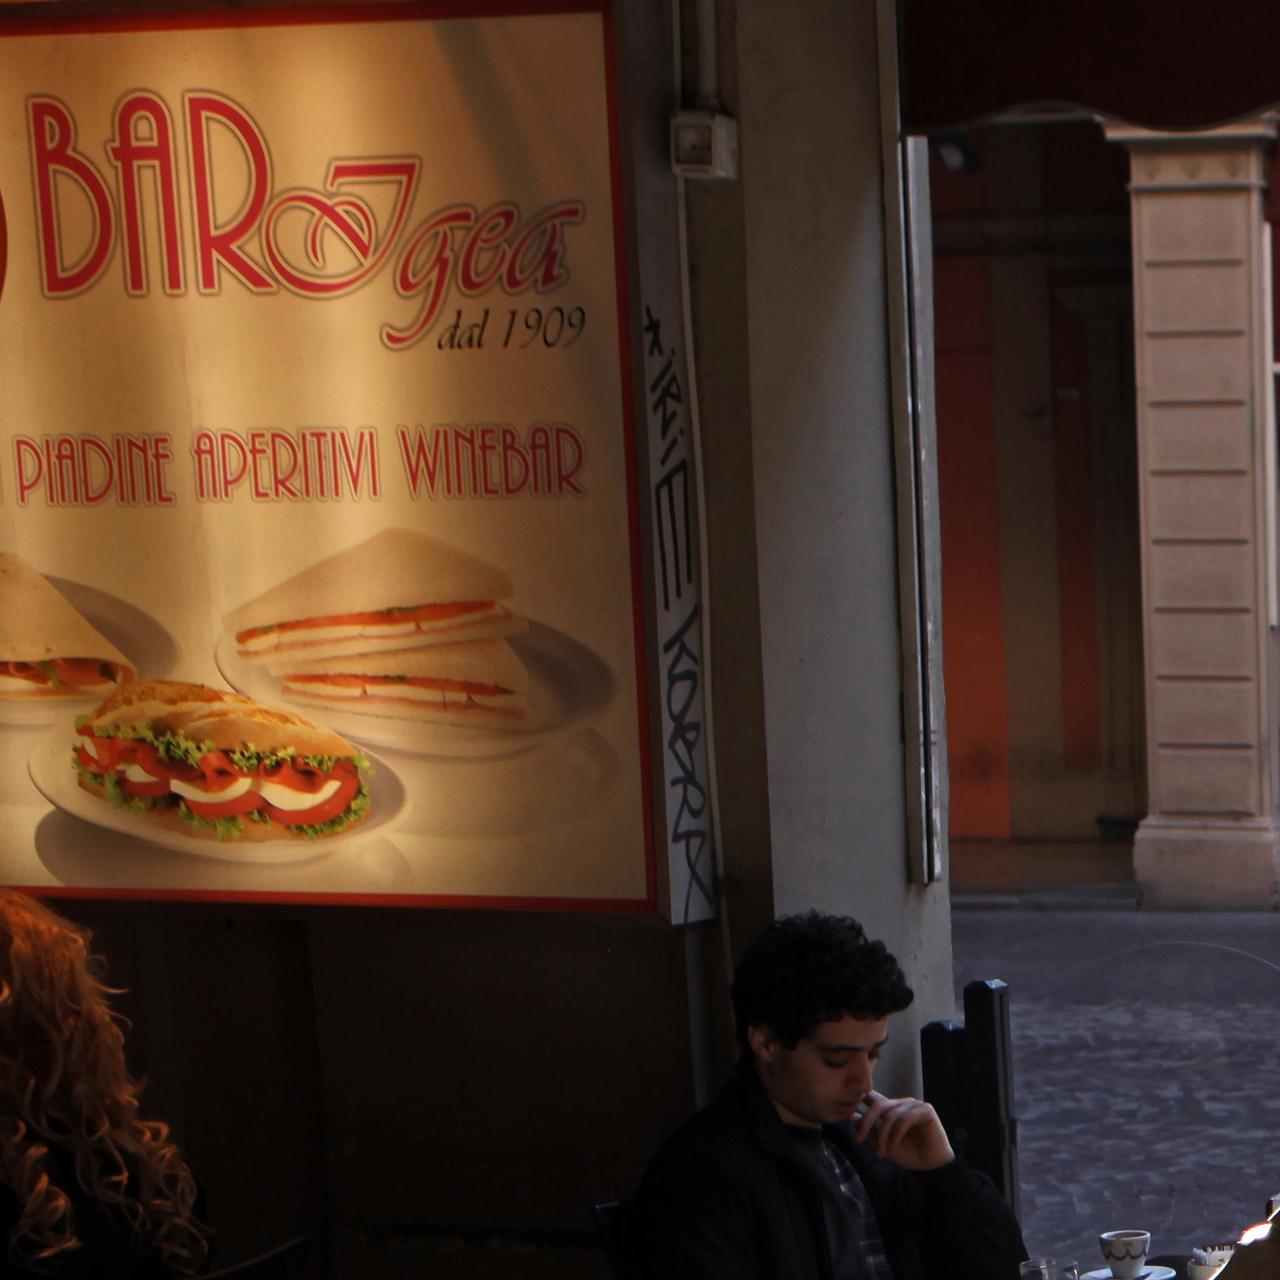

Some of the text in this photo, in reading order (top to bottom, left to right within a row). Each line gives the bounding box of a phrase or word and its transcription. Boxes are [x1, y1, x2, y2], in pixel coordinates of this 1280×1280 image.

[28, 92, 276, 293] BAR
[437, 305, 587, 352] dal 1909
[13, 424, 586, 506] PIADINE APERITIVI WINEBAR
